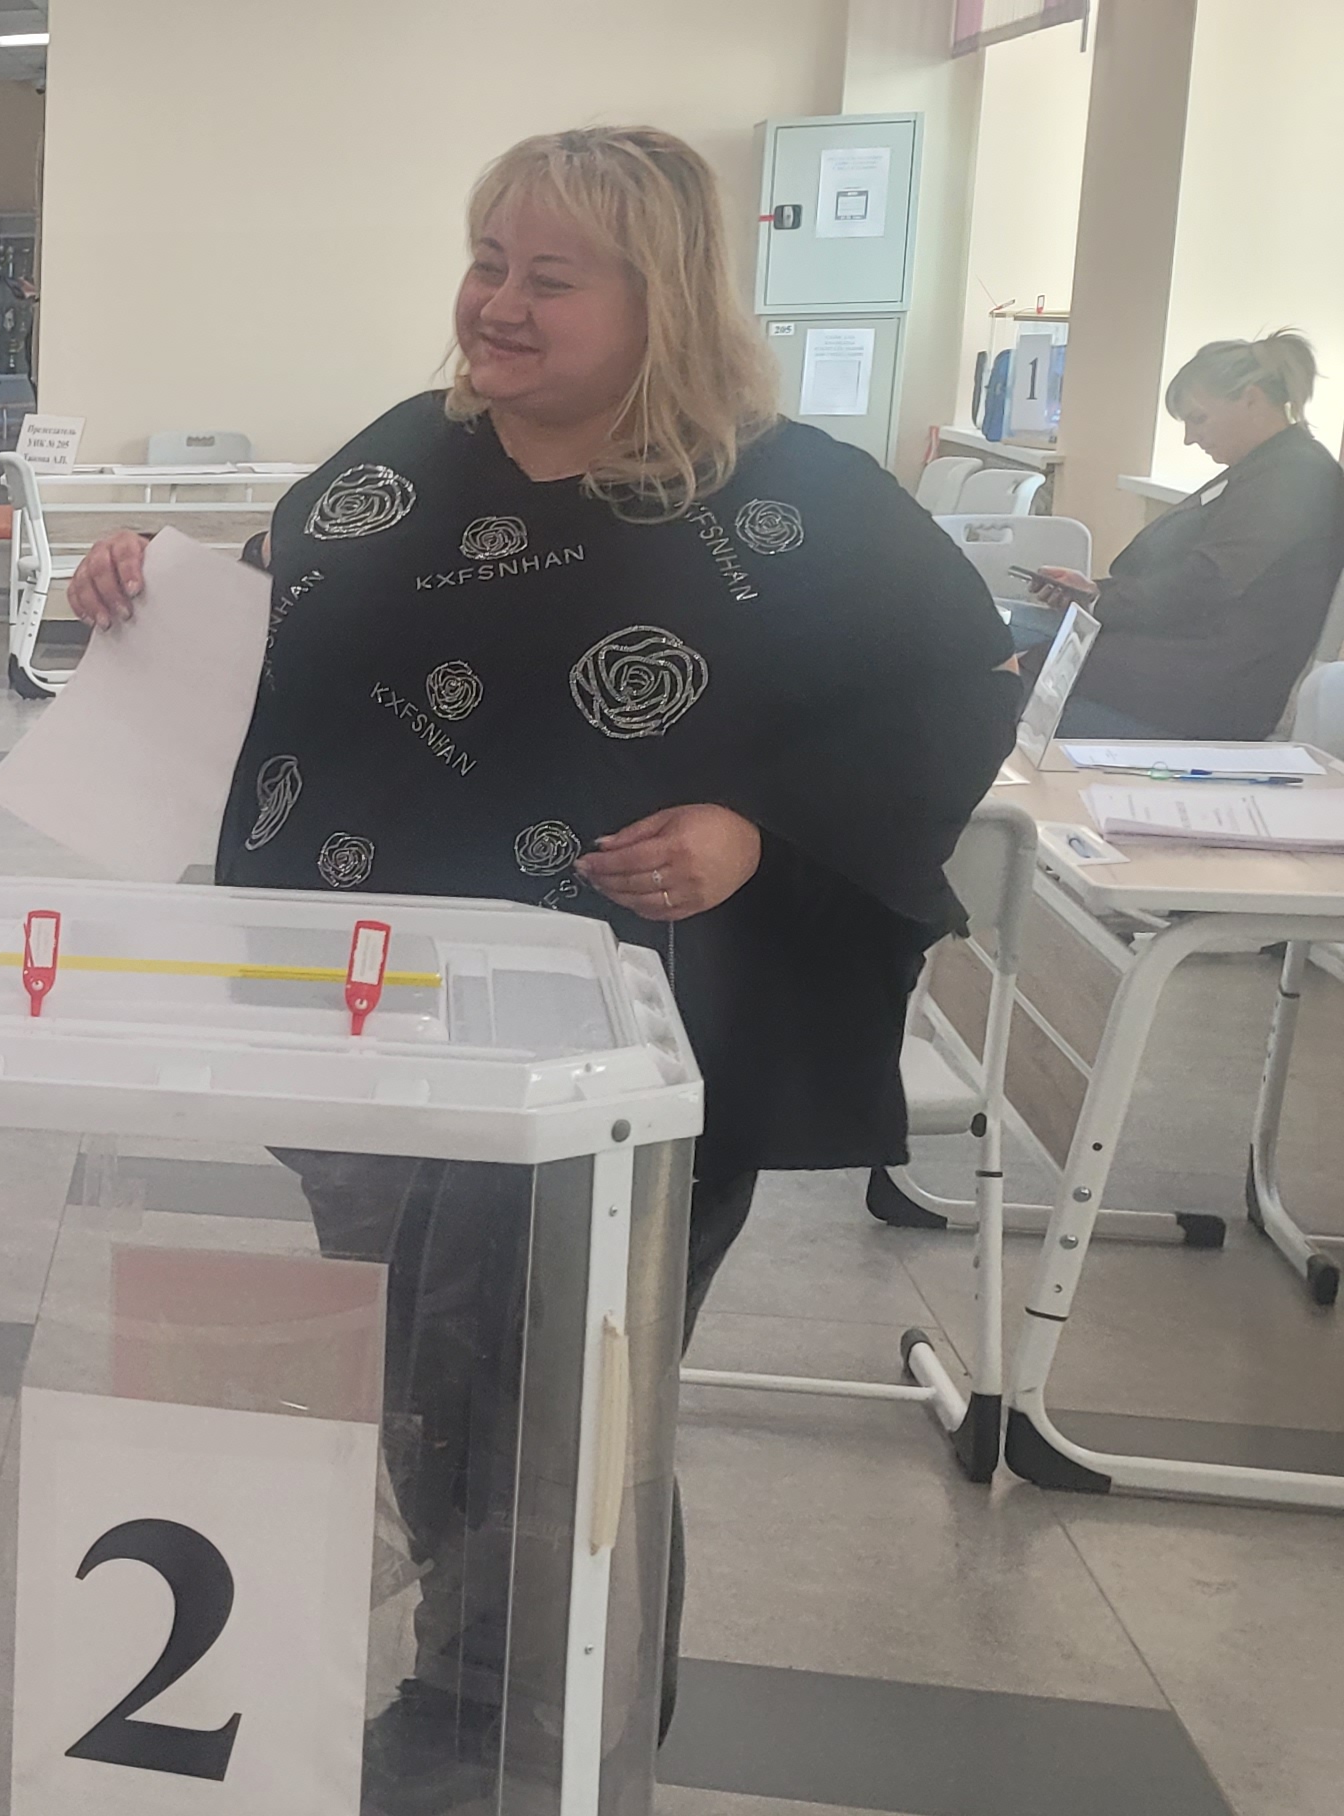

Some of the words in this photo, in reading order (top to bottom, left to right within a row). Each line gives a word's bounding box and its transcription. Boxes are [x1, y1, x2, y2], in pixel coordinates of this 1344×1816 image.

[774, 325, 792, 334] 205
[1026, 357, 1038, 400] 1
[415, 544, 586, 591] KXFSNHAN
[370, 681, 478, 777] KXFSNHAN
[64, 1517, 242, 1782] 2
